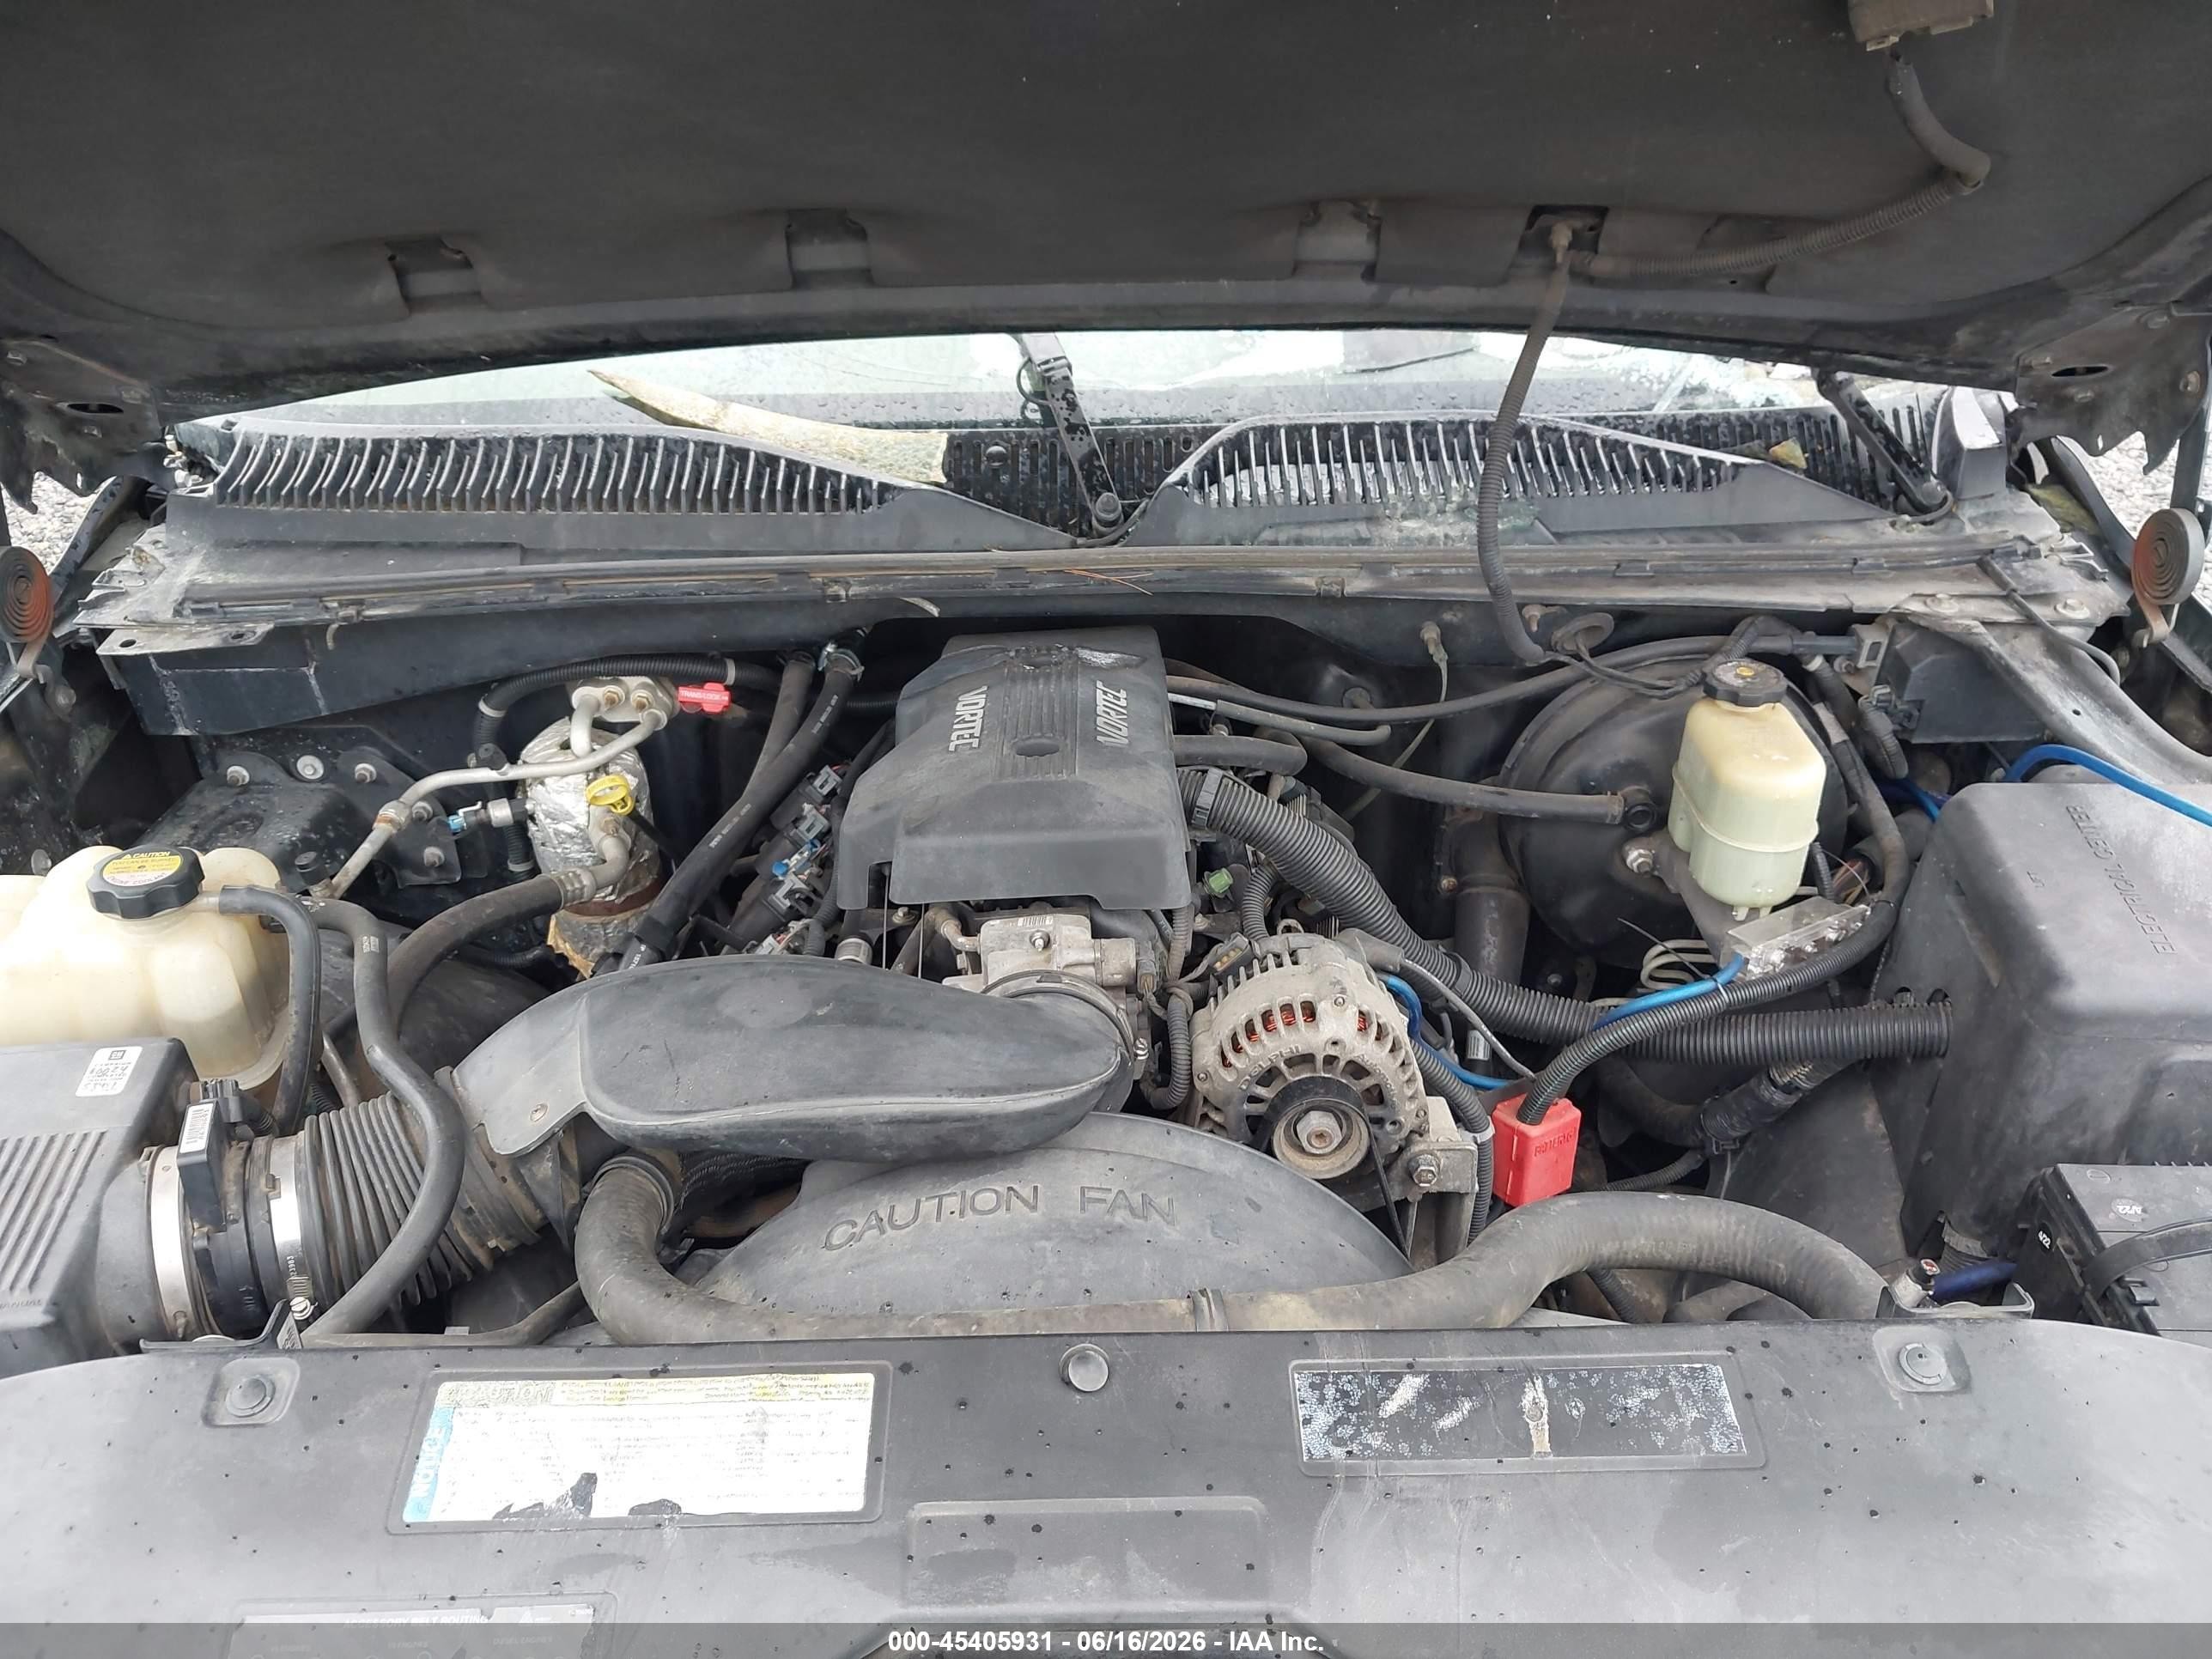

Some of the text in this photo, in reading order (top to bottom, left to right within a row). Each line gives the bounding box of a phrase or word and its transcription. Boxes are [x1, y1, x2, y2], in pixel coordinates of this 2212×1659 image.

[948, 685, 989, 753] VORTEC
[1096, 680, 1128, 745] VORTEC
[2066, 805, 2116, 860] CENTER
[2106, 863, 2179, 956] ELECTRICAL
[1237, 1044, 1303, 1091] DELPHI
[823, 1185, 1176, 1252] CAUTION FAN
[343, 1614, 489, 1629] ACCESSORY BELT ROUTING
